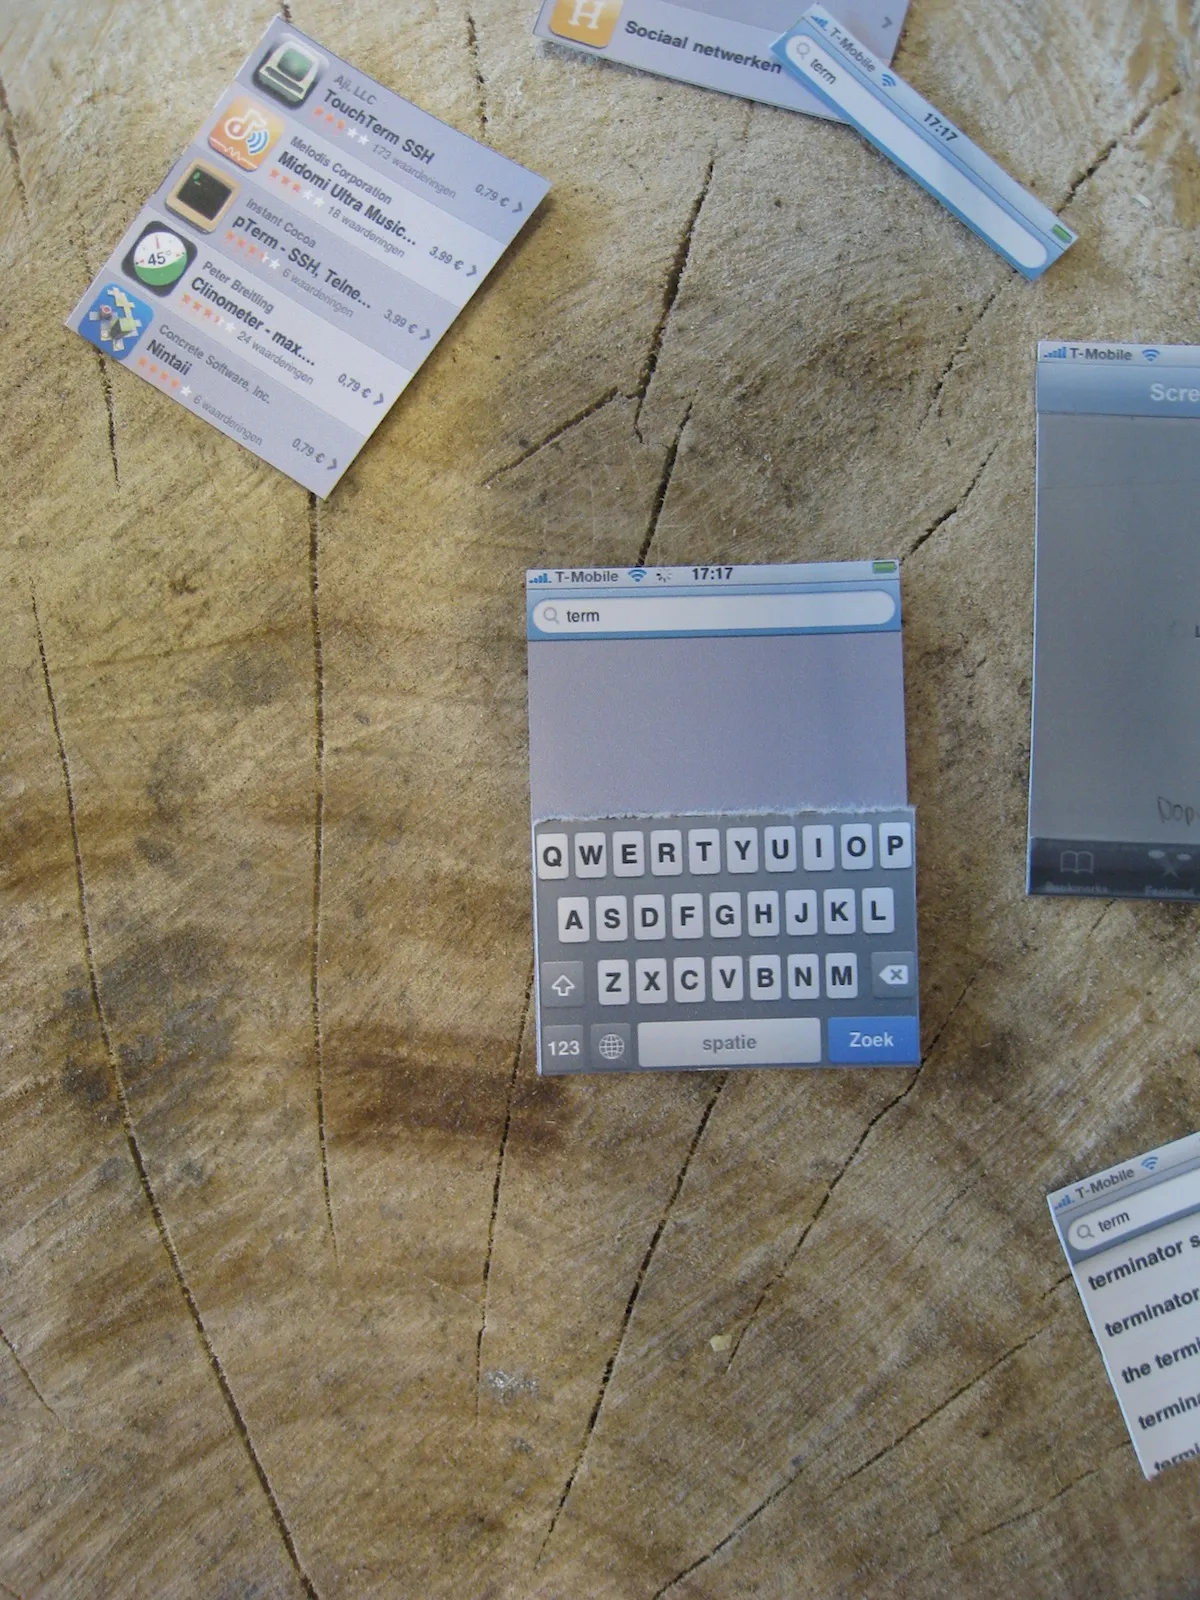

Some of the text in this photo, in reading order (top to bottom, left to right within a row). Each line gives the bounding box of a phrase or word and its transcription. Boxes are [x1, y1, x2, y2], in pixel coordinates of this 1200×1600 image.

[625, 20, 782, 75] Sociaal netwerken
[829, 26, 877, 74] T-Mobile
[809, 57, 838, 86] term
[353, 86, 377, 105] LLC
[324, 88, 435, 165] TouchTerm SSH
[923, 112, 958, 142] 17:17
[278, 151, 331, 191] Midomi
[330, 184, 363, 212] Ultra
[290, 136, 392, 205] Melodis Corporation
[393, 157, 456, 199] waarderingen
[475, 183, 499, 201] 0,79
[246, 198, 317, 249] Instant Cocoa
[328, 206, 405, 258] 18 waarderingen
[232, 216, 279, 250] pTerm
[288, 248, 321, 278] SSH,
[429, 246, 453, 265] 3,99
[191, 277, 264, 330] Clinometer
[202, 261, 275, 315] Peter Breitling
[292, 274, 354, 318] waarderingen
[383, 309, 407, 328] 3,99
[146, 339, 193, 376] Nintaii
[159, 324, 270, 404] Concrete Software, Inc.
[237, 331, 314, 385] 24 waarderingen
[1069, 347, 1133, 361] T-Mobile
[338, 373, 361, 392] 0,79
[1150, 383, 1200, 401] Scre
[202, 402, 263, 446] waarderingen
[291, 438, 315, 457] 0,79
[554, 567, 733, 583] T-Mobile 17:17
[566, 608, 600, 623] term
[542, 835, 904, 868] Q W E R T Y U I O P
[564, 901, 886, 930] A S D F G H J K L
[605, 966, 853, 993] Z X C V B N M
[548, 1032, 894, 1056] 123 spatie Zoek
[1075, 1167, 1135, 1199] T-Mobile
[1098, 1211, 1130, 1232] term
[1088, 1241, 1183, 1291] terminator
[1104, 1288, 1199, 1337] terminator
[1122, 1363, 1151, 1384] the
